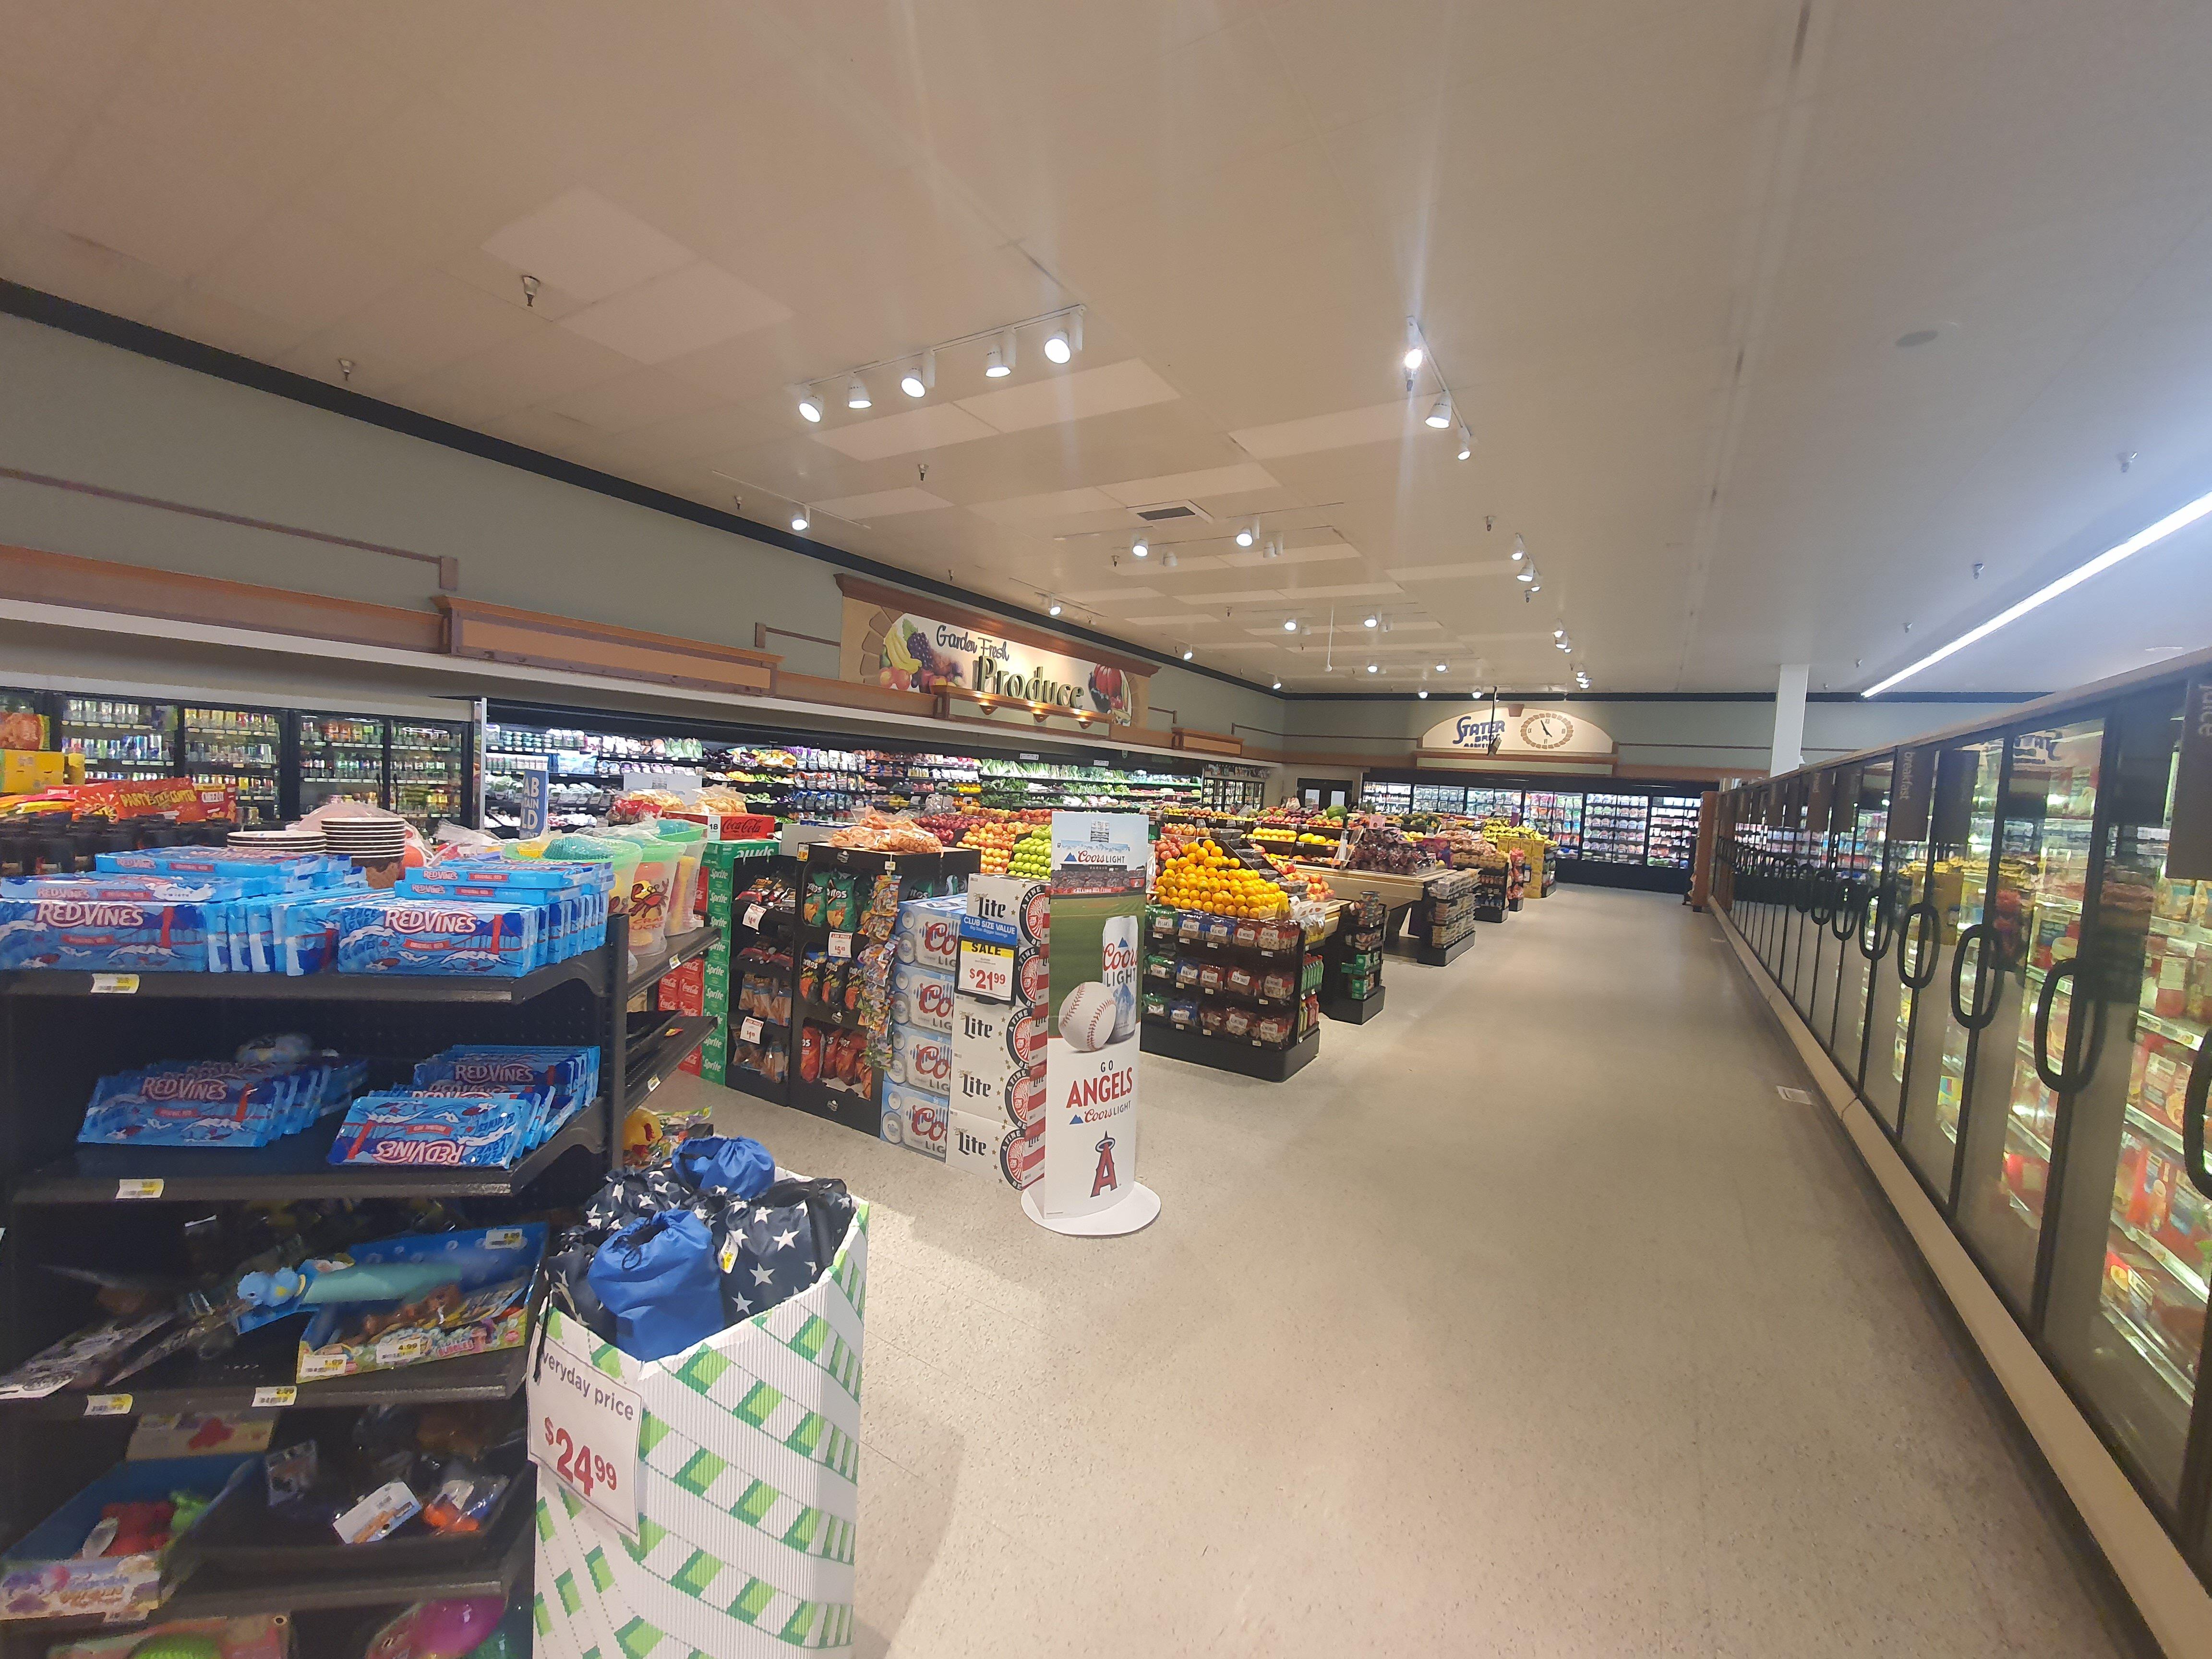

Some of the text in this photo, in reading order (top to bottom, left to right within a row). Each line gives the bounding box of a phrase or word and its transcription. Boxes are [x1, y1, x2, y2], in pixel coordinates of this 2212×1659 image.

[936, 625, 1010, 662] Garden Fresh
[976, 655, 1084, 709] Produce
[1899, 752, 1916, 800] breakfast
[1078, 850, 1104, 863] Coors
[709, 868, 729, 880] Sprite
[709, 892, 728, 903] Sprite
[1024, 886, 1041, 902] FINE
[977, 897, 1006, 919] Lite
[709, 916, 728, 927] Sprite
[964, 916, 1015, 935] CLUB SIZE VALUE
[971, 942, 1001, 956] SALE
[1103, 943, 1137, 971] Coors
[706, 964, 724, 976] Sprite
[1106, 968, 1136, 987] LIGHT
[706, 988, 724, 1000] Sprite
[1013, 1009, 1028, 1025] FINE
[964, 1014, 993, 1039] Lite
[703, 1059, 721, 1072] Sprite
[1100, 1060, 1113, 1073] GO
[962, 1074, 991, 1098] Lite
[1010, 1070, 1026, 1085] FINE
[1066, 1067, 1132, 1108] ANGELS
[1084, 1100, 1131, 1123] Coors LIGHT
[958, 1132, 986, 1155] Lite
[1005, 1130, 1021, 1144] FINE
[539, 1350, 635, 1421] veryday price
